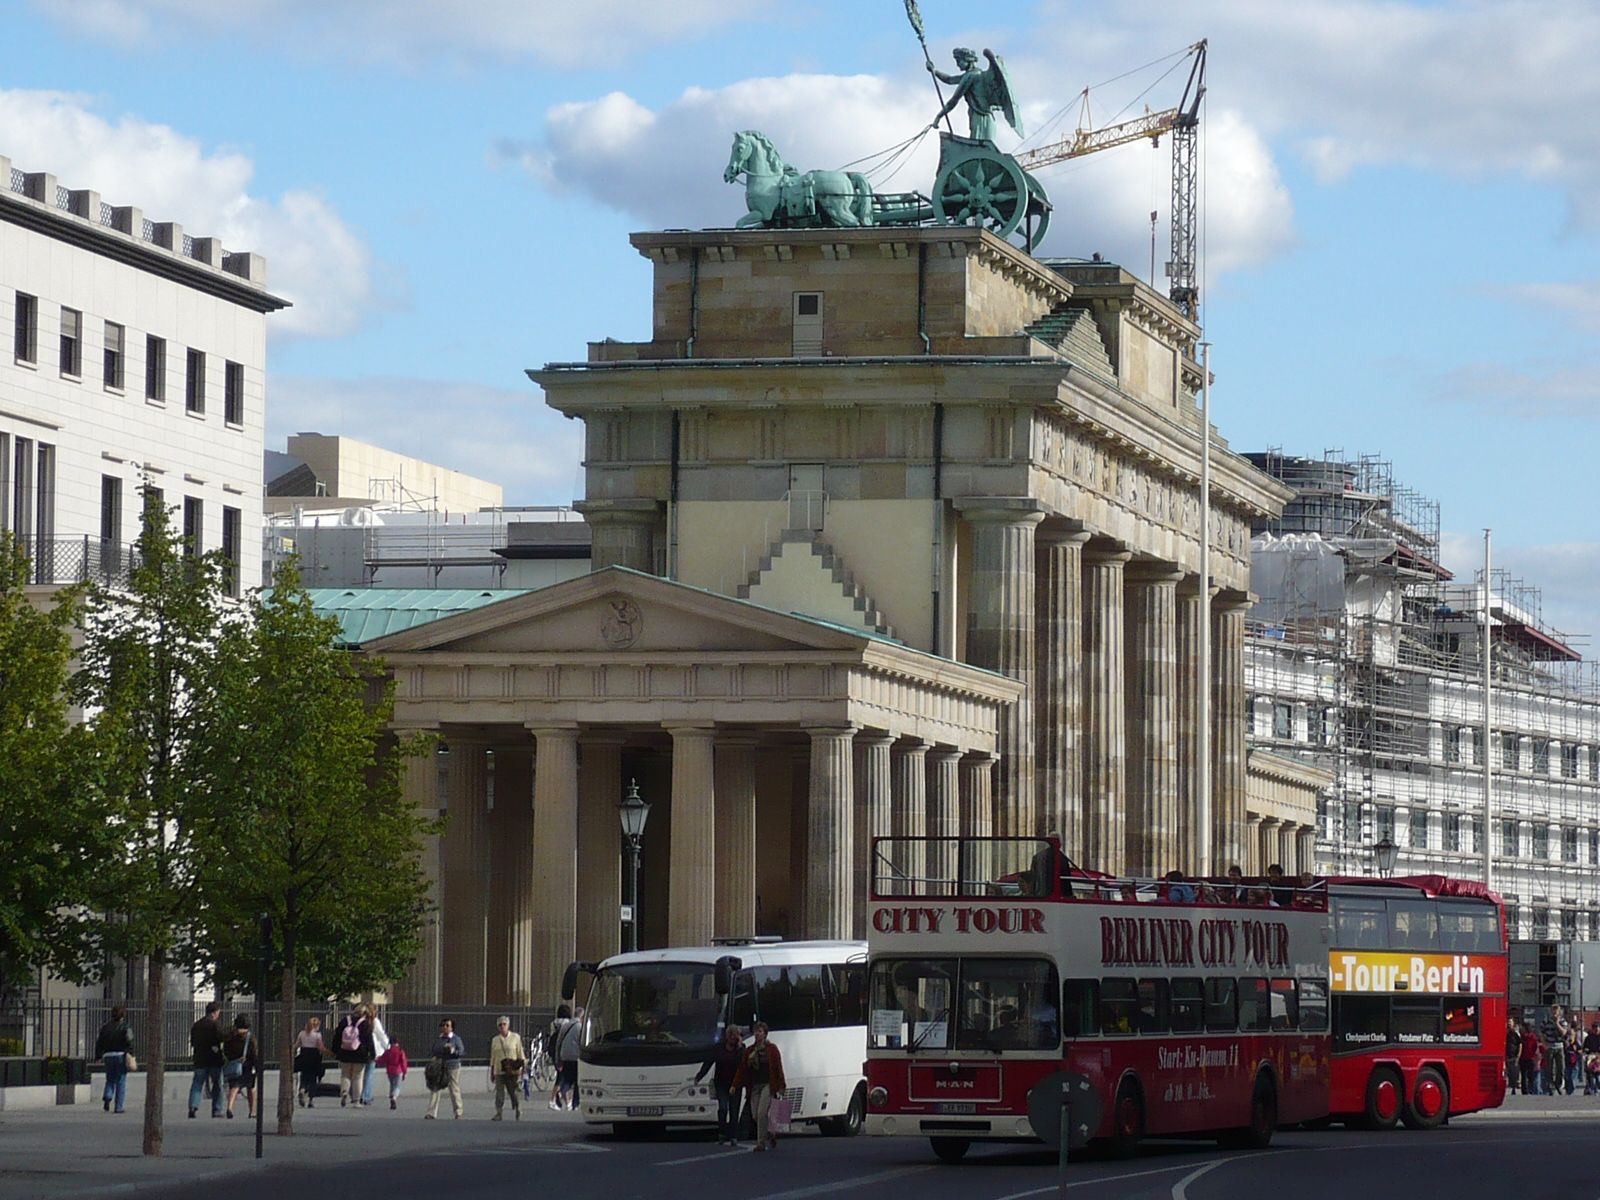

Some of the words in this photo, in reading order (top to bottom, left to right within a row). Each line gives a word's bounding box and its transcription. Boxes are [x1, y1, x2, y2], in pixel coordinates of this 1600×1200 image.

[872, 906, 944, 933] CITY
[952, 906, 1047, 934] TOUR
[1100, 916, 1195, 967] BERLINER
[1199, 917, 1238, 968] CITY
[1241, 917, 1290, 969] TOUR
[1330, 955, 1484, 993] -Tour-Berlin
[1345, 1032, 1371, 1043] Checkpoint
[1371, 1032, 1387, 1042] Charlie
[1398, 1033, 1422, 1043] Potsdamer
[1422, 1033, 1434, 1043] Platz
[1158, 1046, 1183, 1070] Start:
[1184, 1045, 1227, 1069] Ku-Damm
[1229, 1043, 1239, 1066] 11
